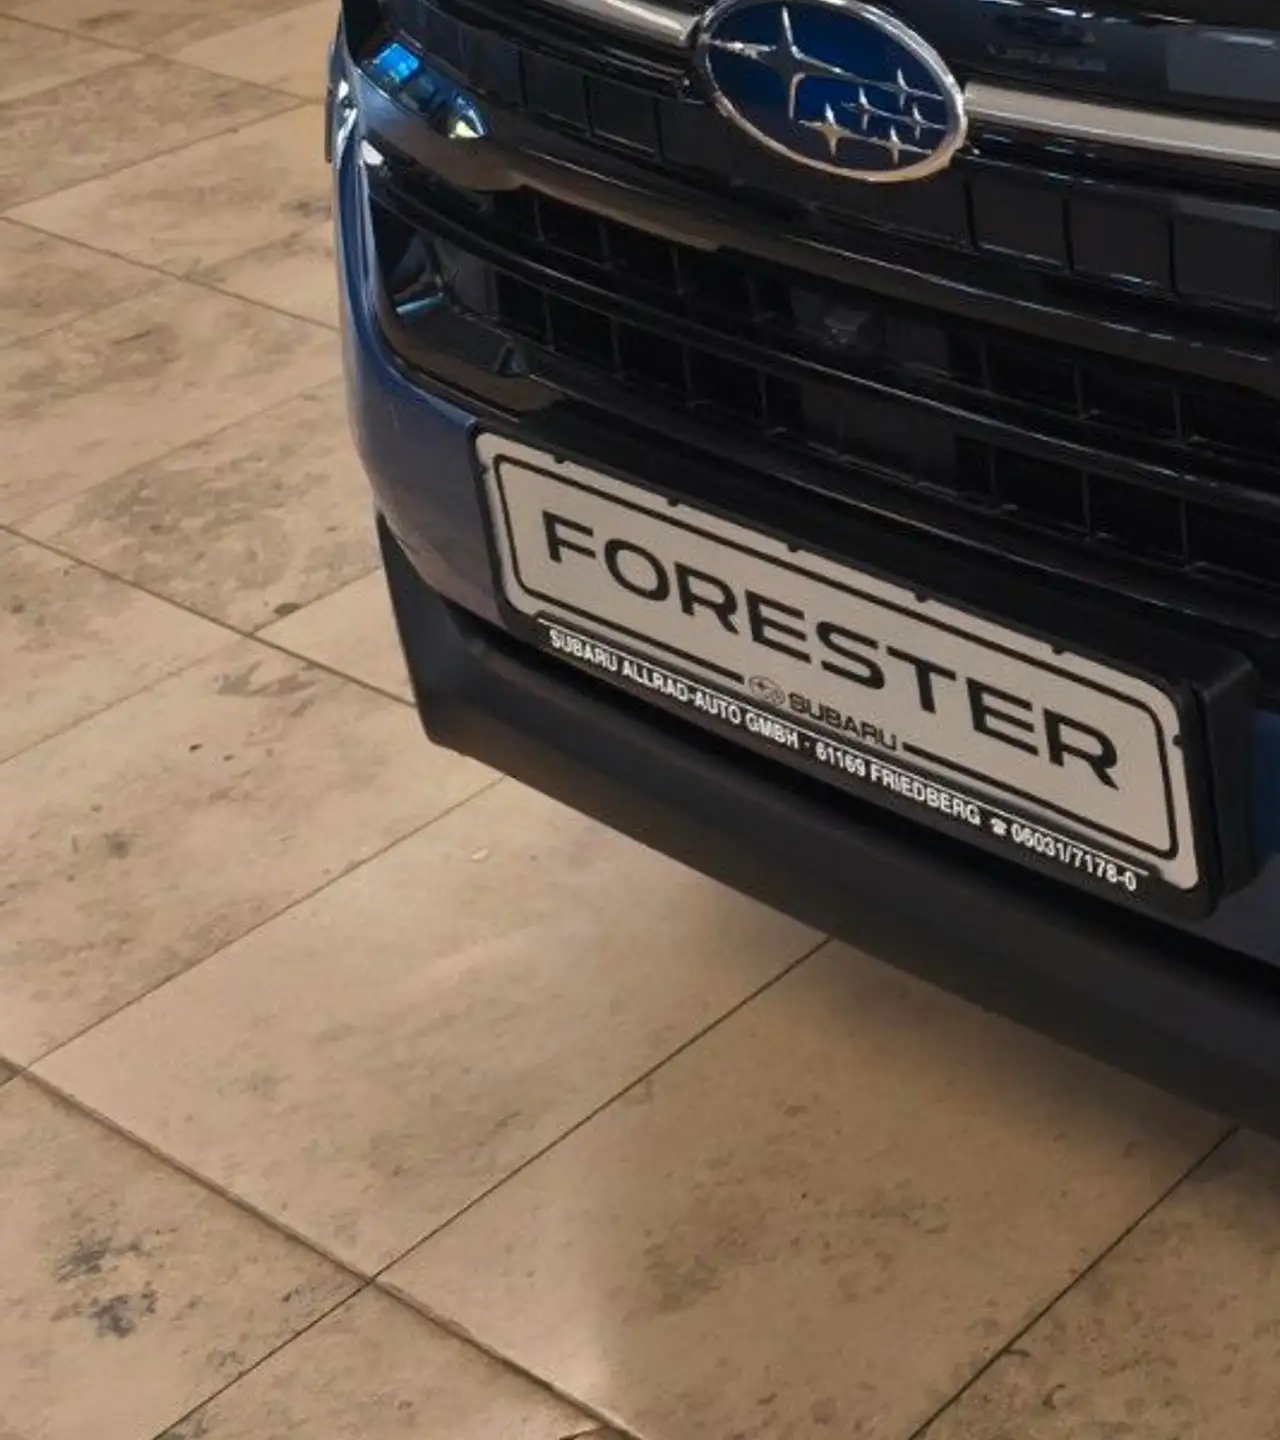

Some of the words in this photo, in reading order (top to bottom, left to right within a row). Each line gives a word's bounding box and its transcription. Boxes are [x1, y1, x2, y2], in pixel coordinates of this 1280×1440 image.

[541, 510, 1120, 791] FORESTER
[550, 628, 618, 672] SUBARU
[621, 659, 742, 725] ALLRAD-AUTO
[745, 711, 800, 750] GMBH
[815, 740, 867, 778] 61169
[870, 763, 982, 827] FRIEDBERG
[788, 691, 897, 751] SUBARU
